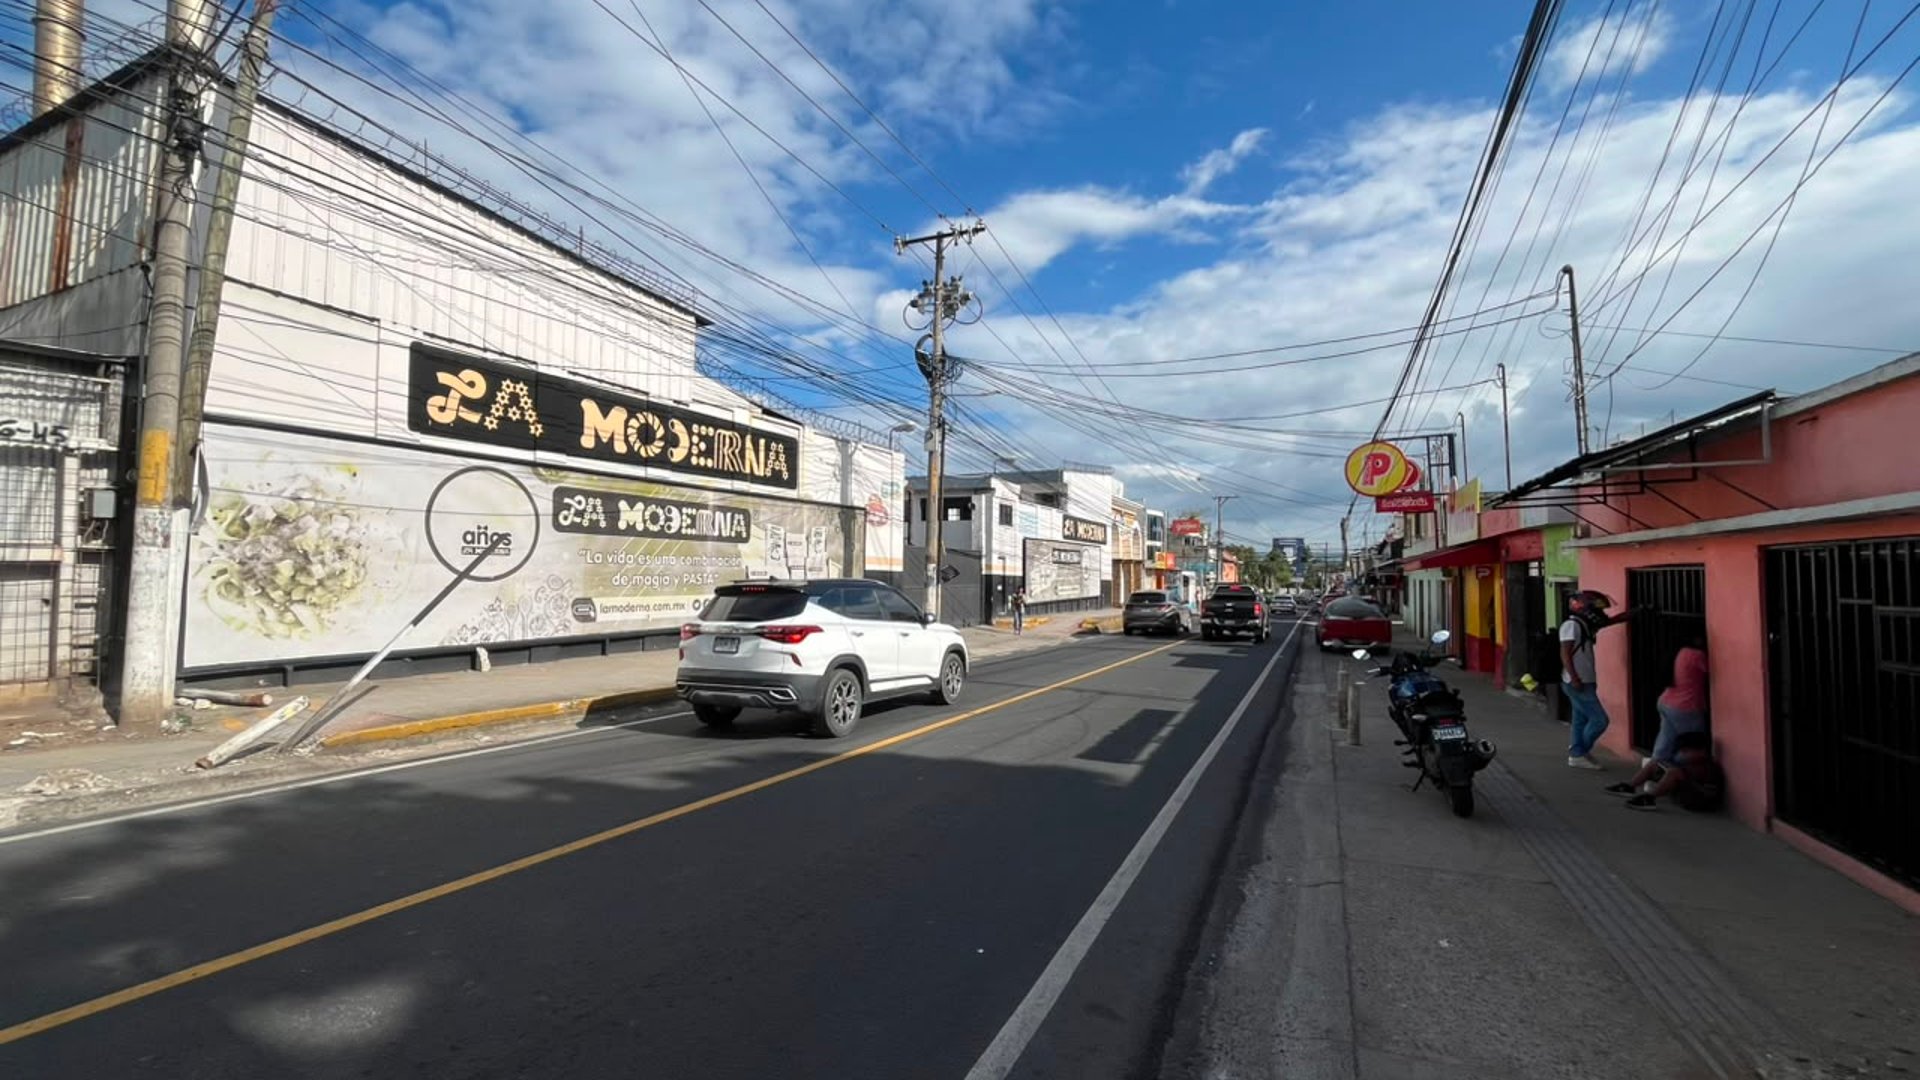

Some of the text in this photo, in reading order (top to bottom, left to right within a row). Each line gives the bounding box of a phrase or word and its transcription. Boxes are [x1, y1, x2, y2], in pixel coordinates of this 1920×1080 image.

[426, 369, 789, 481] LA MODERNA
[558, 494, 747, 538] LA MODERNA
[462, 524, 512, 546] años
[606, 550, 635, 565] vida
[638, 553, 651, 565] es
[655, 554, 676, 565] una
[612, 573, 629, 586] de
[633, 574, 670, 589] magia
[673, 577, 679, 587] y
[599, 602, 686, 614] lamoderna.com.mx
